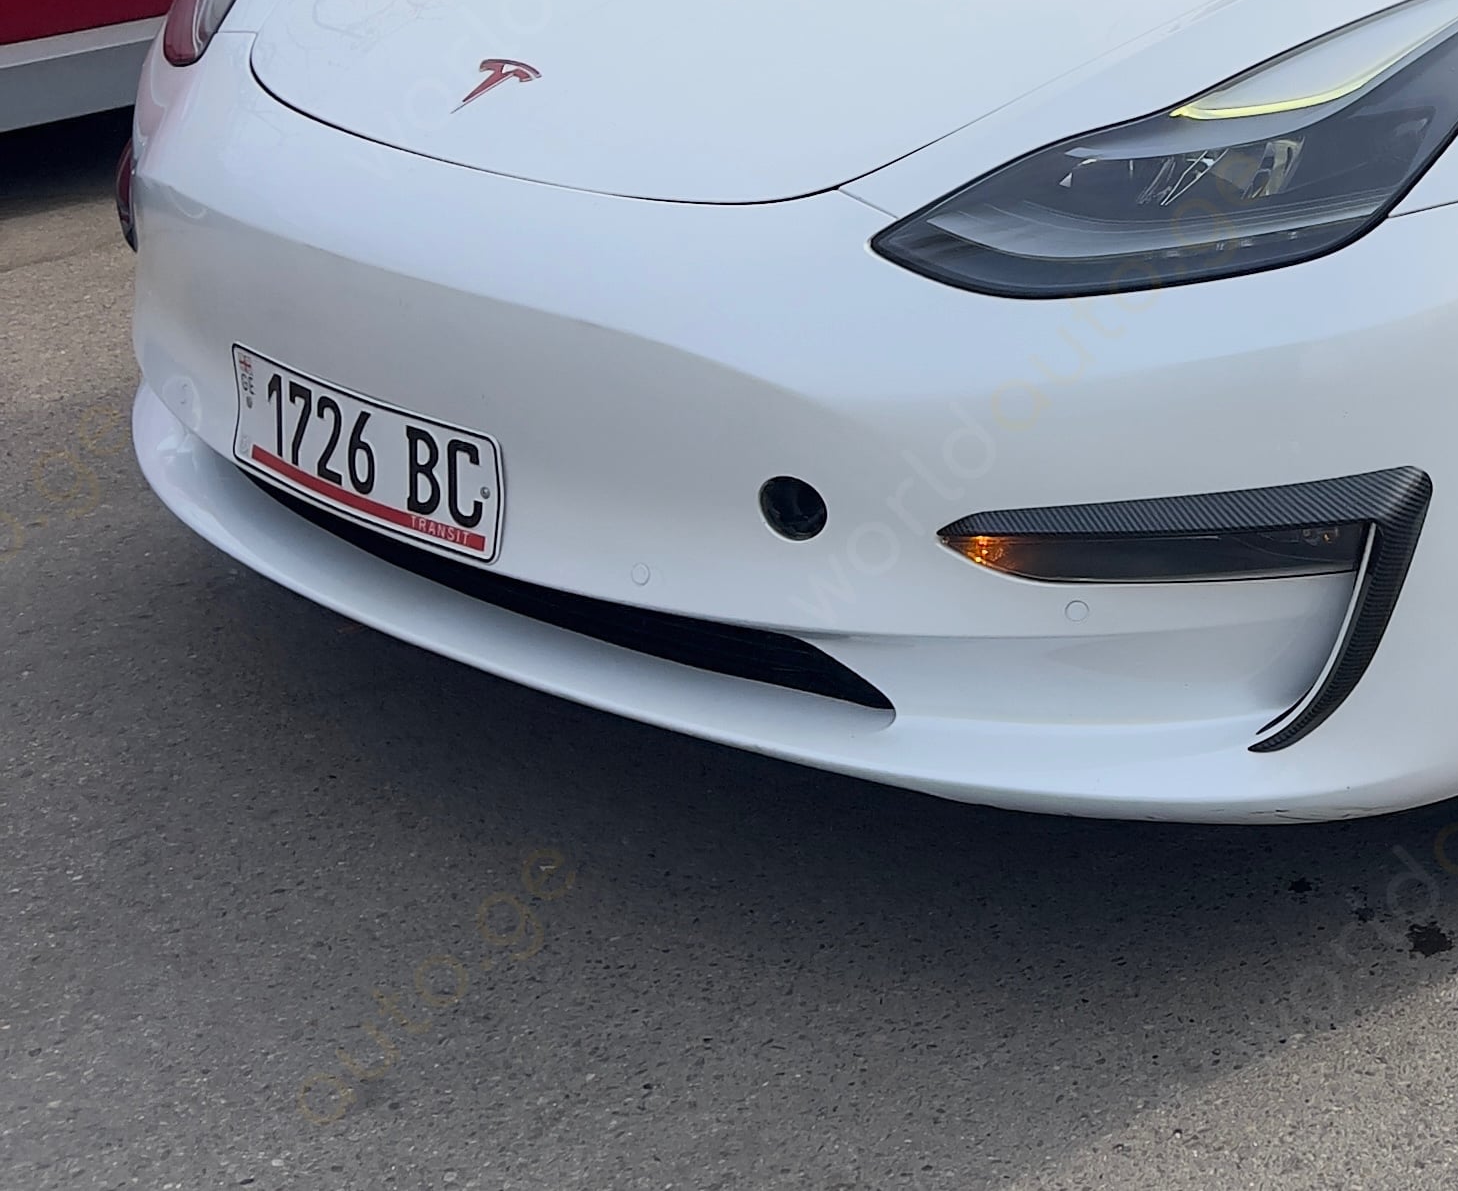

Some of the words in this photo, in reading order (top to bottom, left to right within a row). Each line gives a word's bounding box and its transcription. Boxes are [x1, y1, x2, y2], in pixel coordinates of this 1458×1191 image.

[267, 373, 375, 495] 1726
[405, 424, 483, 528] BC
[410, 515, 471, 546] TRANSIT
